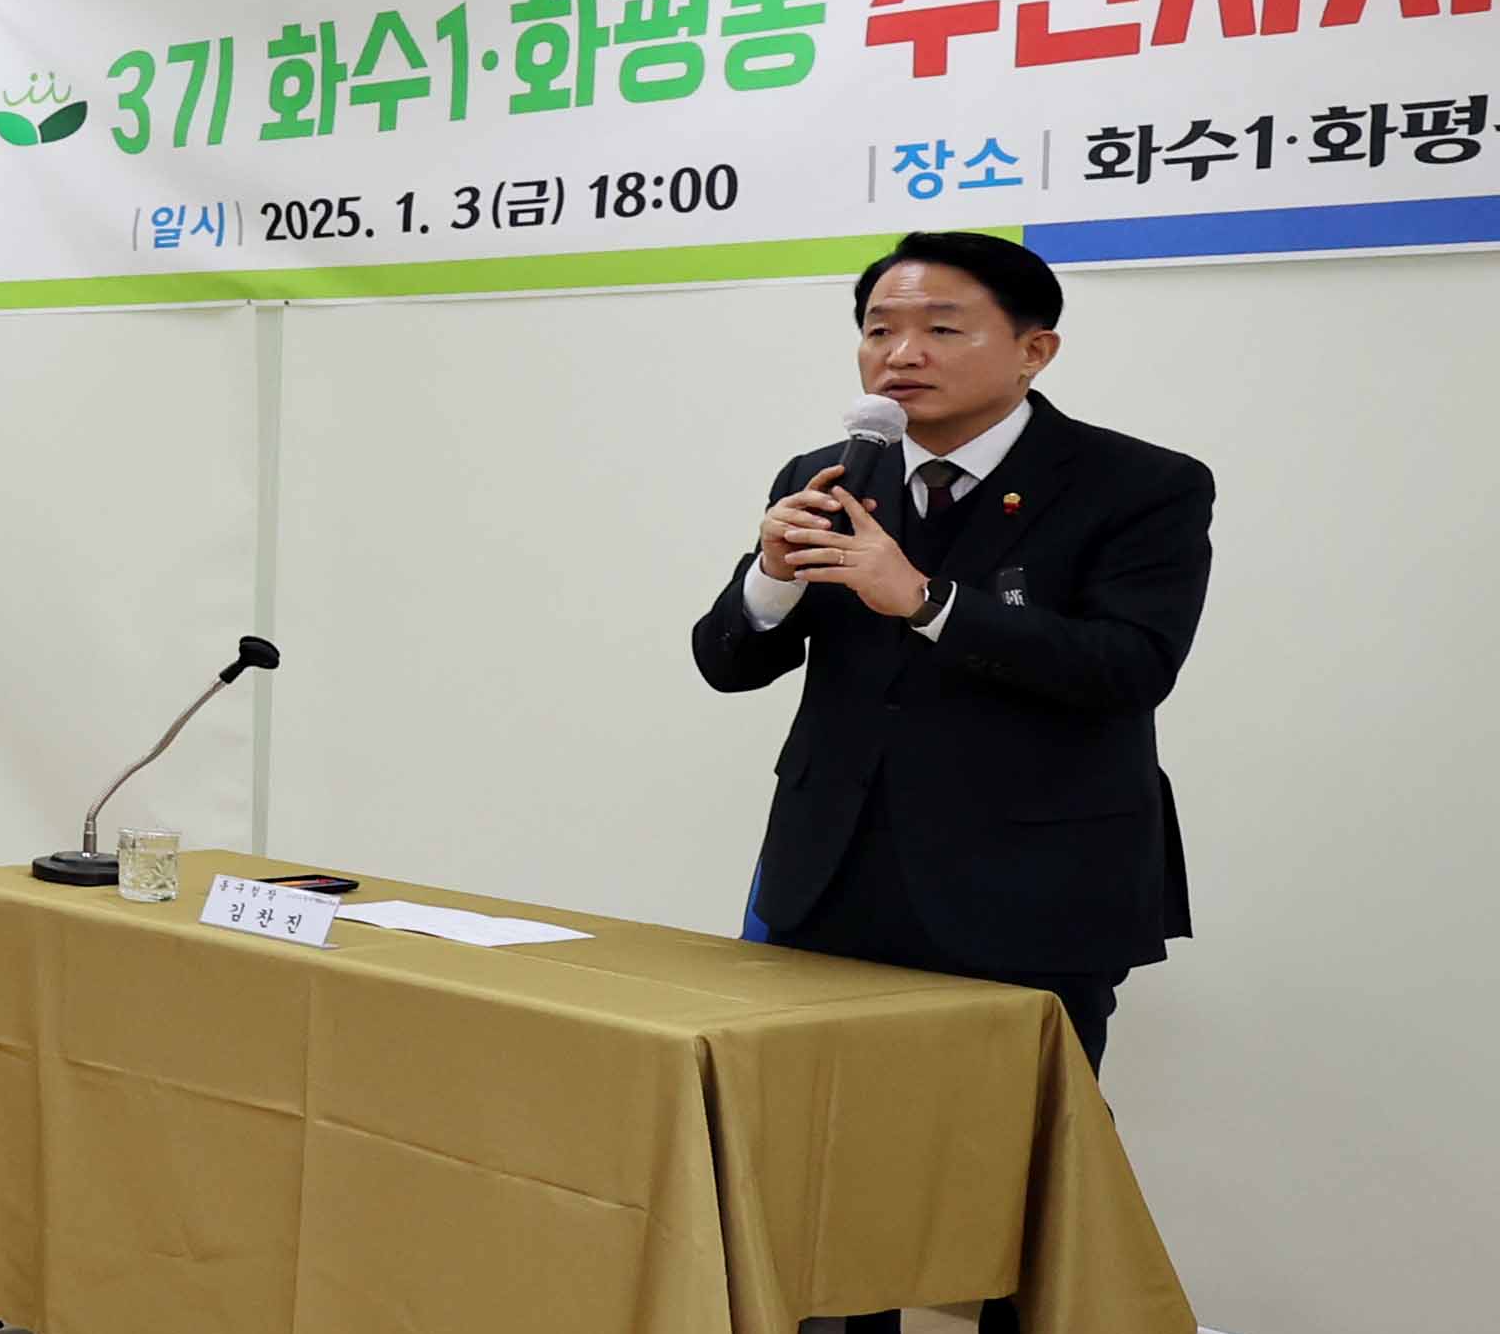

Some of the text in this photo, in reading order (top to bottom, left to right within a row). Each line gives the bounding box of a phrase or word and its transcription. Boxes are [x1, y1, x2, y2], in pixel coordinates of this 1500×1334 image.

[106, 35, 235, 156] 3기
[891, 93, 1500, 201] 장소 화수1·화평
[151, 163, 739, 249] 일시 2025. 1. 3(금) 18:00
